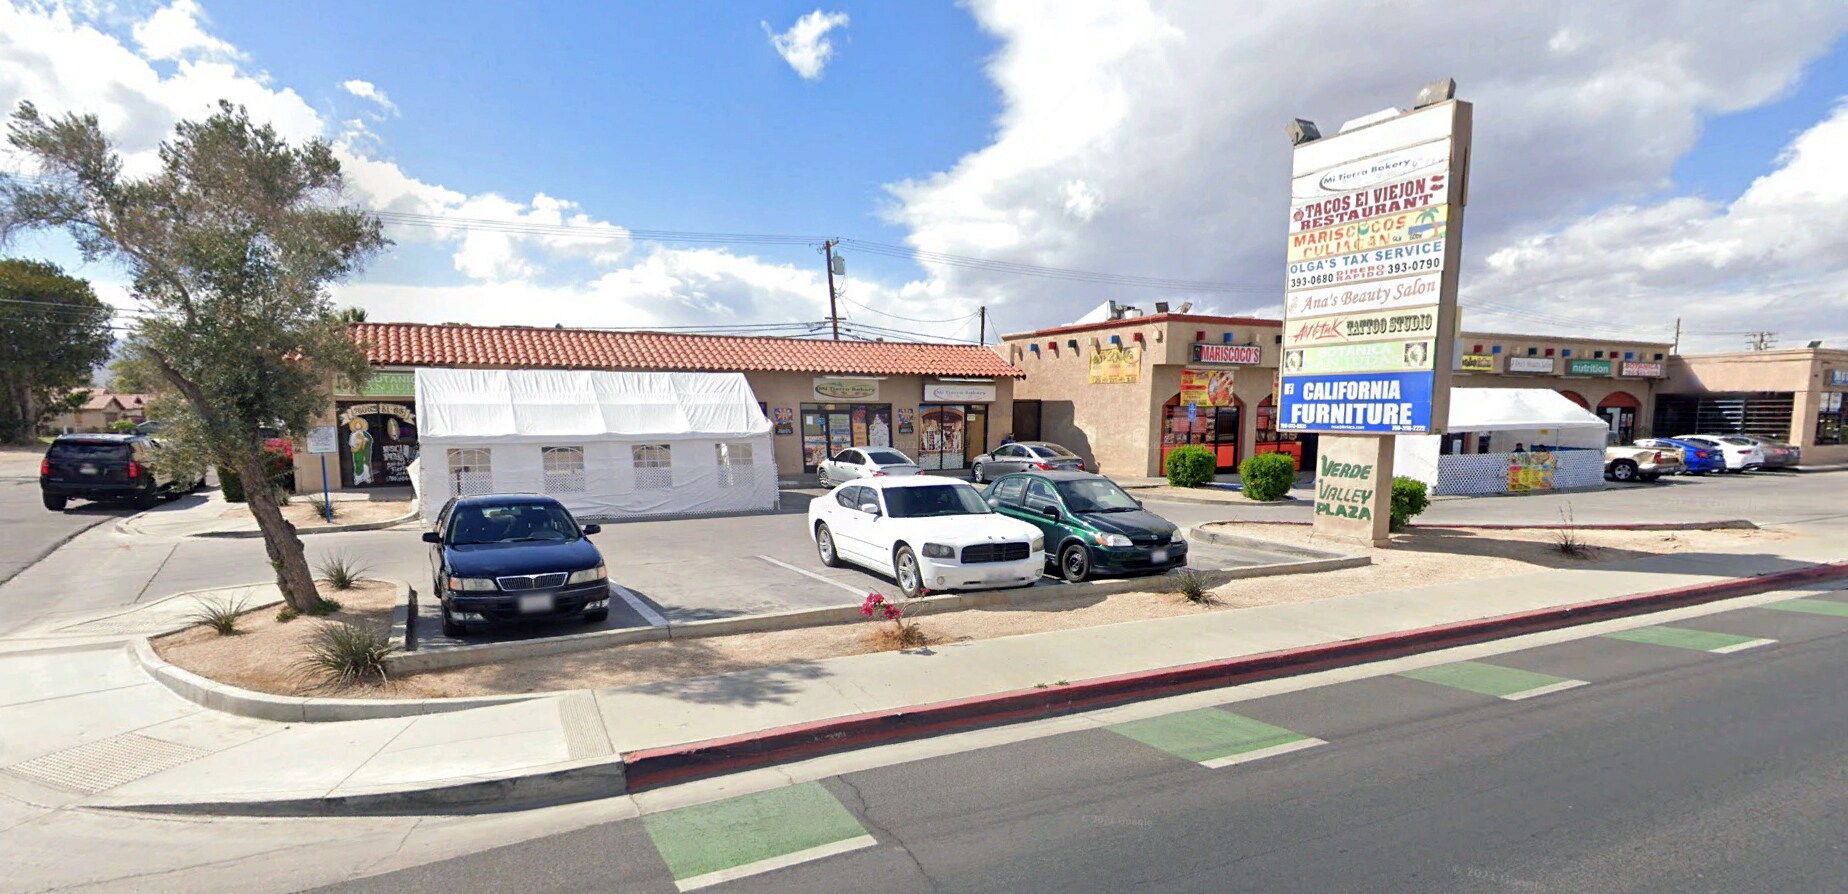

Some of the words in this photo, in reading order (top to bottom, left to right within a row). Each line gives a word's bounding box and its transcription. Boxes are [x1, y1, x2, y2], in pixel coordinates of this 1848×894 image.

[1305, 195, 1351, 219] TACOS
[1373, 178, 1427, 202] VIEJON
[1300, 193, 1434, 231] RESTAURANT
[1290, 259, 1337, 275] OLGA'S
[1342, 253, 1371, 267] TAX
[1375, 241, 1443, 262] SERVICE
[1387, 257, 1441, 275] 393-0790
[1290, 273, 1334, 289] 393-0680
[1335, 270, 1385, 282] RAPIDO
[1336, 264, 1385, 276] DINERO
[1301, 293, 1339, 313] Ana's
[1341, 285, 1391, 307] Beauty
[1393, 278, 1437, 300] Salon
[1346, 318, 1387, 337] TATTOO
[1388, 313, 1434, 334] STUDIO
[1201, 345, 1260, 364] MARISCOCO'S
[1572, 363, 1609, 374] nutrition
[1303, 379, 1402, 401] CALIFORNIA
[1291, 402, 1413, 425] FURNITURE
[1321, 455, 1373, 480] VERDE
[1318, 478, 1373, 505] VALLEY
[1315, 502, 1372, 521] PLAZA
